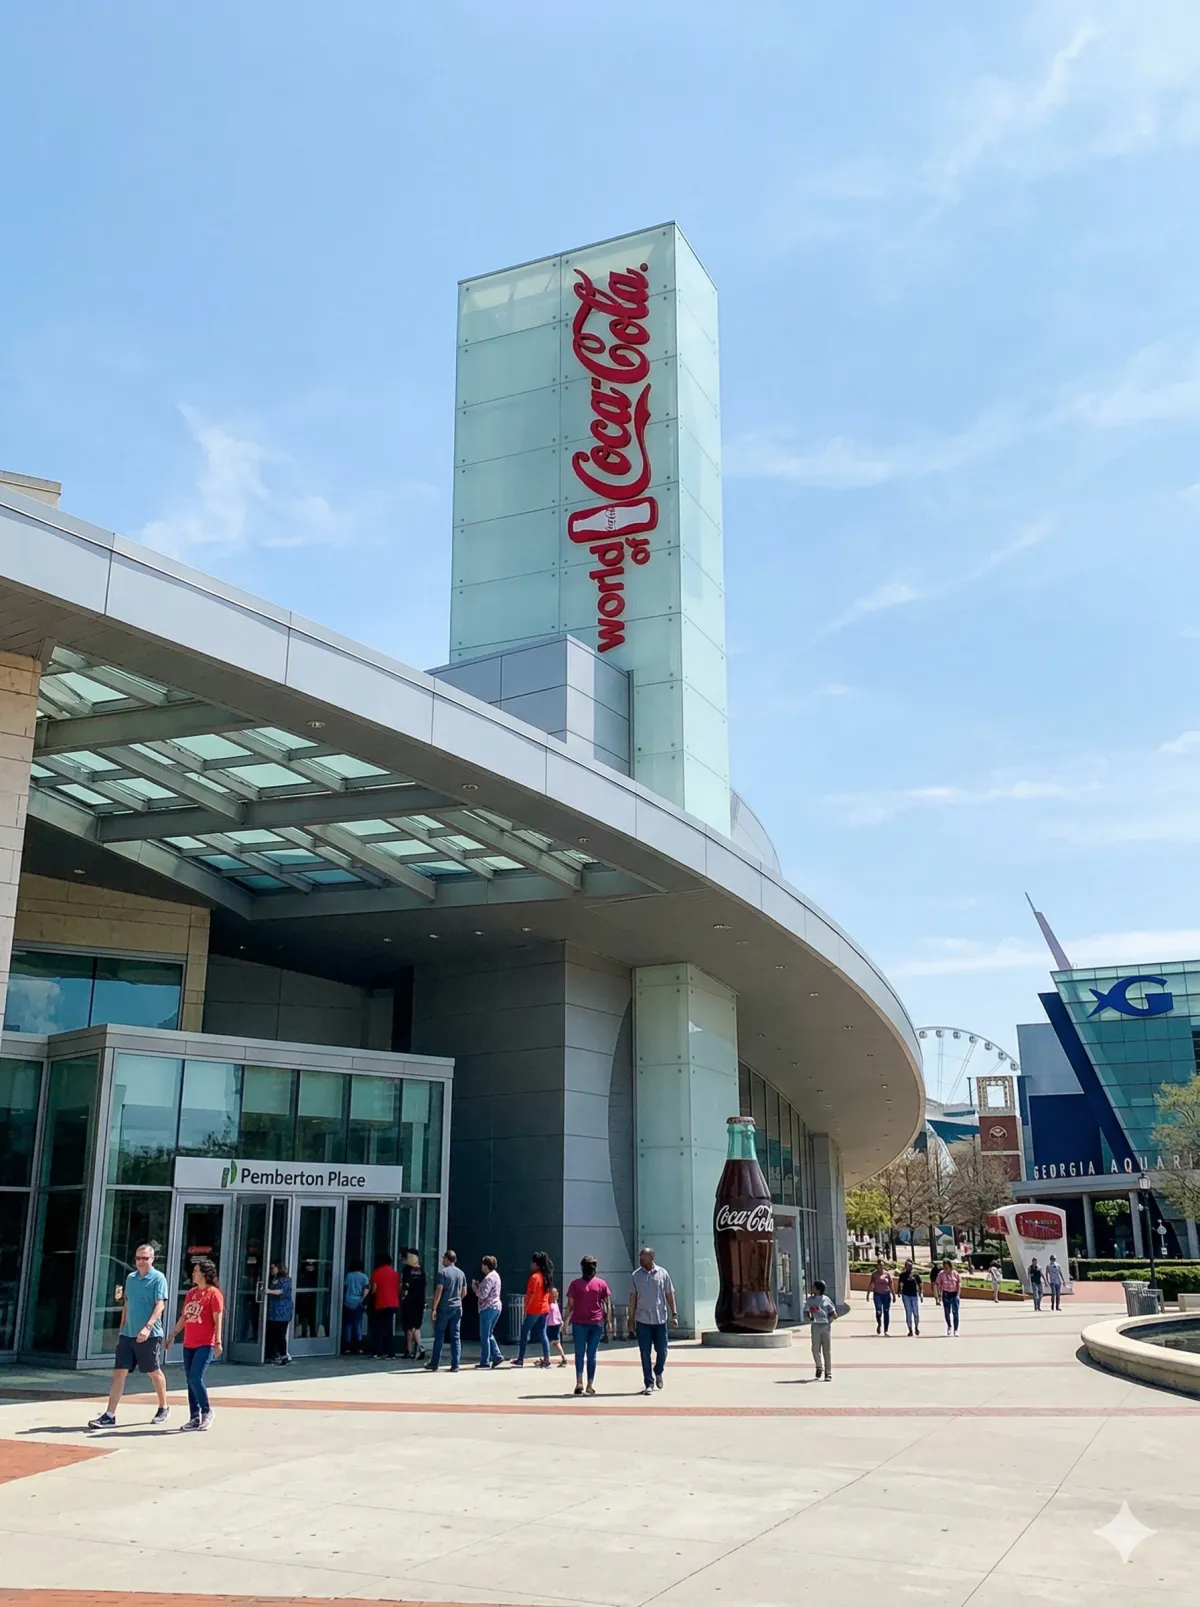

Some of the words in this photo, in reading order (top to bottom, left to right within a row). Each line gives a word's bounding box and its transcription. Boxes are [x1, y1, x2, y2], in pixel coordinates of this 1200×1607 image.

[625, 537, 650, 565] of
[589, 541, 626, 653] world
[240, 1168, 324, 1186] Pemberton
[327, 1171, 366, 1188] Place
[1033, 1161, 1095, 1180] GEORGIA
